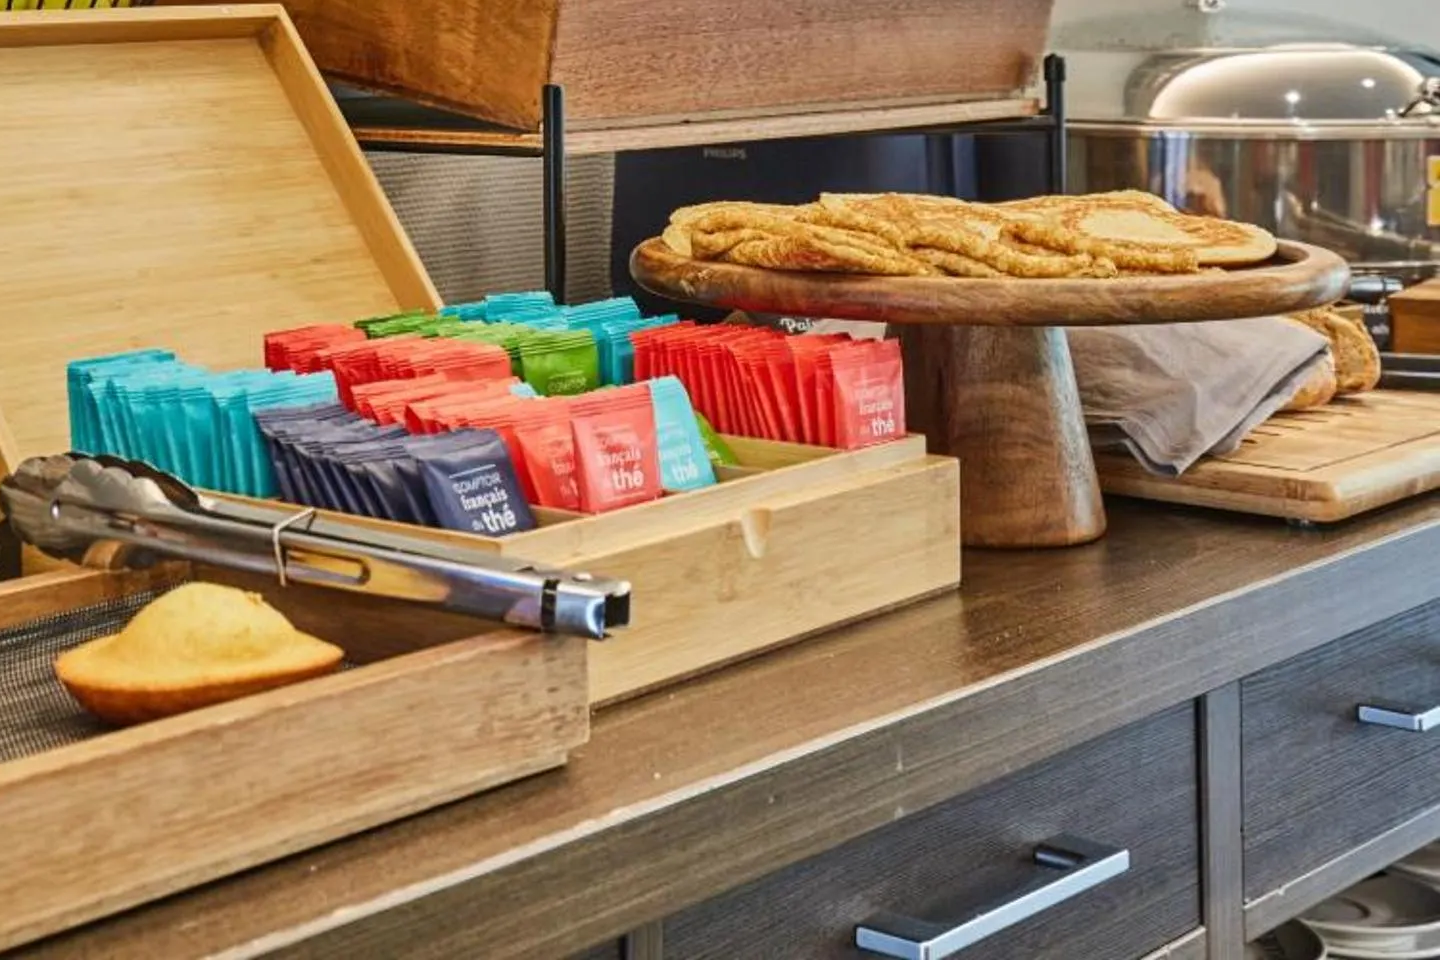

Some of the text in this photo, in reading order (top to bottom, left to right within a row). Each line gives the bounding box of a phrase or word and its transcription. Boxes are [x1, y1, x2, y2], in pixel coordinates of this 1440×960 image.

[611, 464, 645, 490] thé
[460, 486, 508, 511] français
[482, 502, 517, 533] thé
